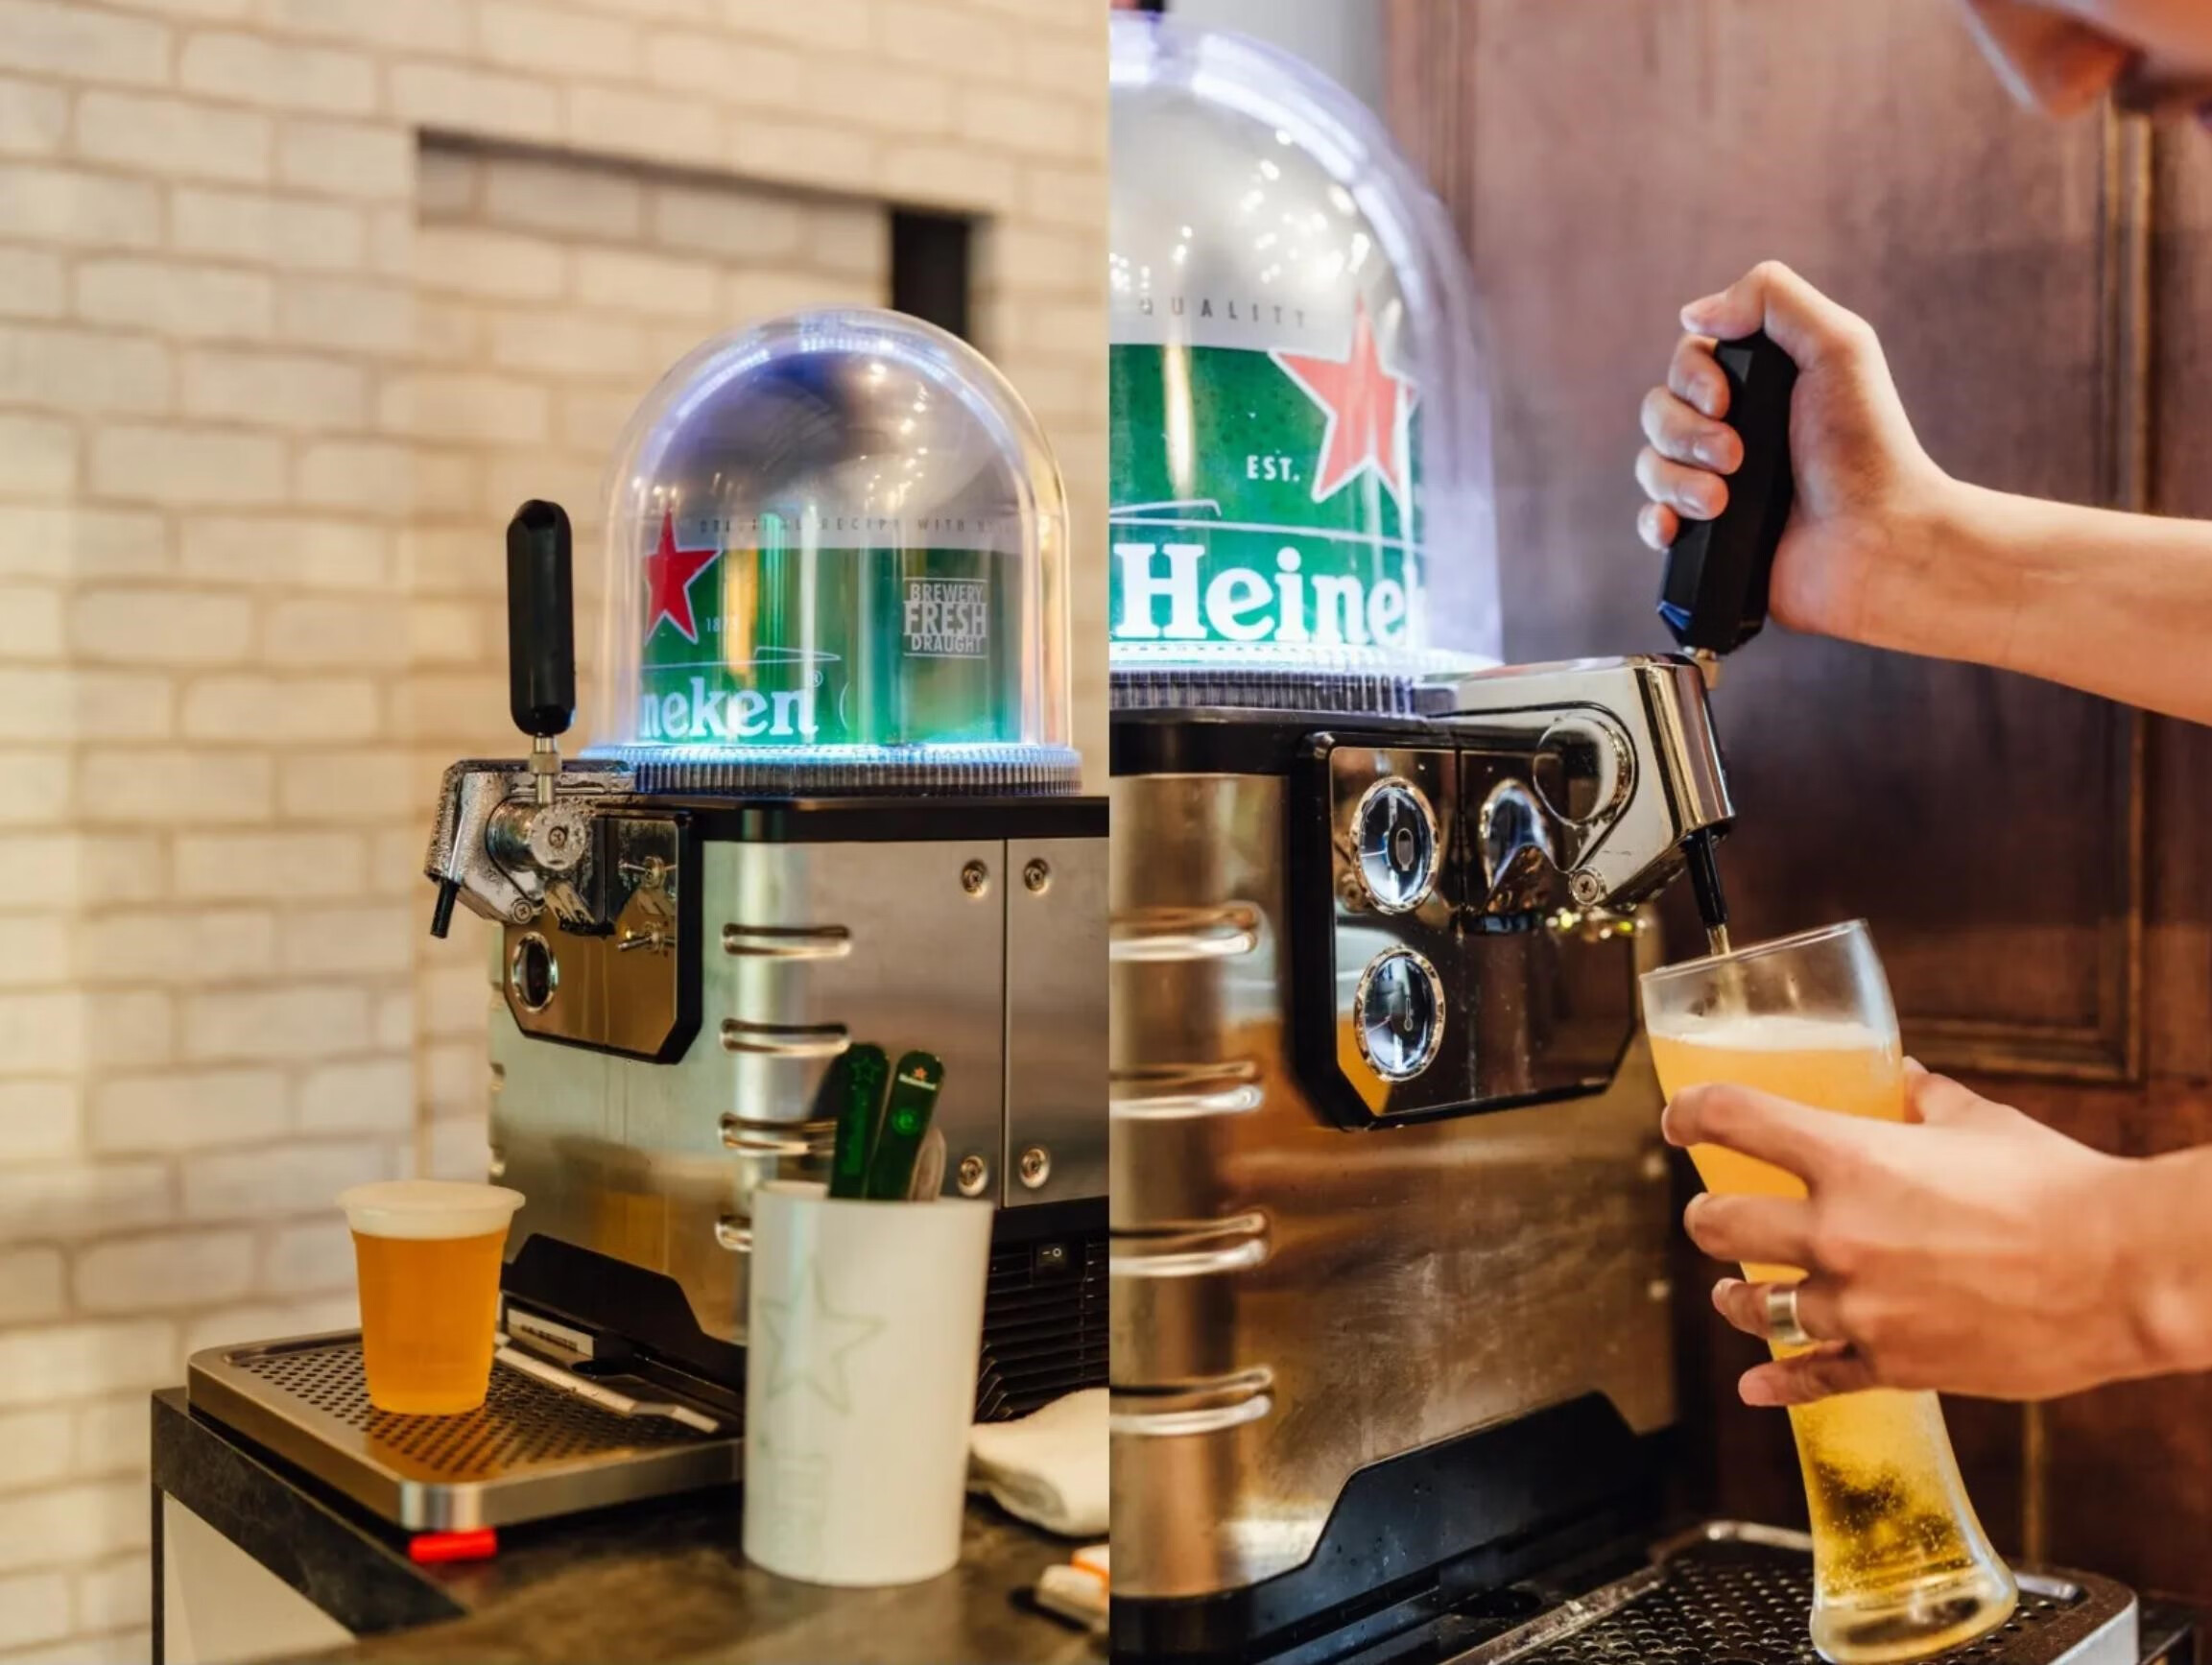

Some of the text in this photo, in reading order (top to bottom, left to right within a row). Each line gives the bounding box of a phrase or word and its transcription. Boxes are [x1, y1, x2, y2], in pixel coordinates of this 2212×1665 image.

[1247, 455, 1300, 482] EST.
[910, 582, 983, 603] BREWERY
[903, 600, 987, 637] FRESH
[911, 634, 983, 653] DRAUGHT
